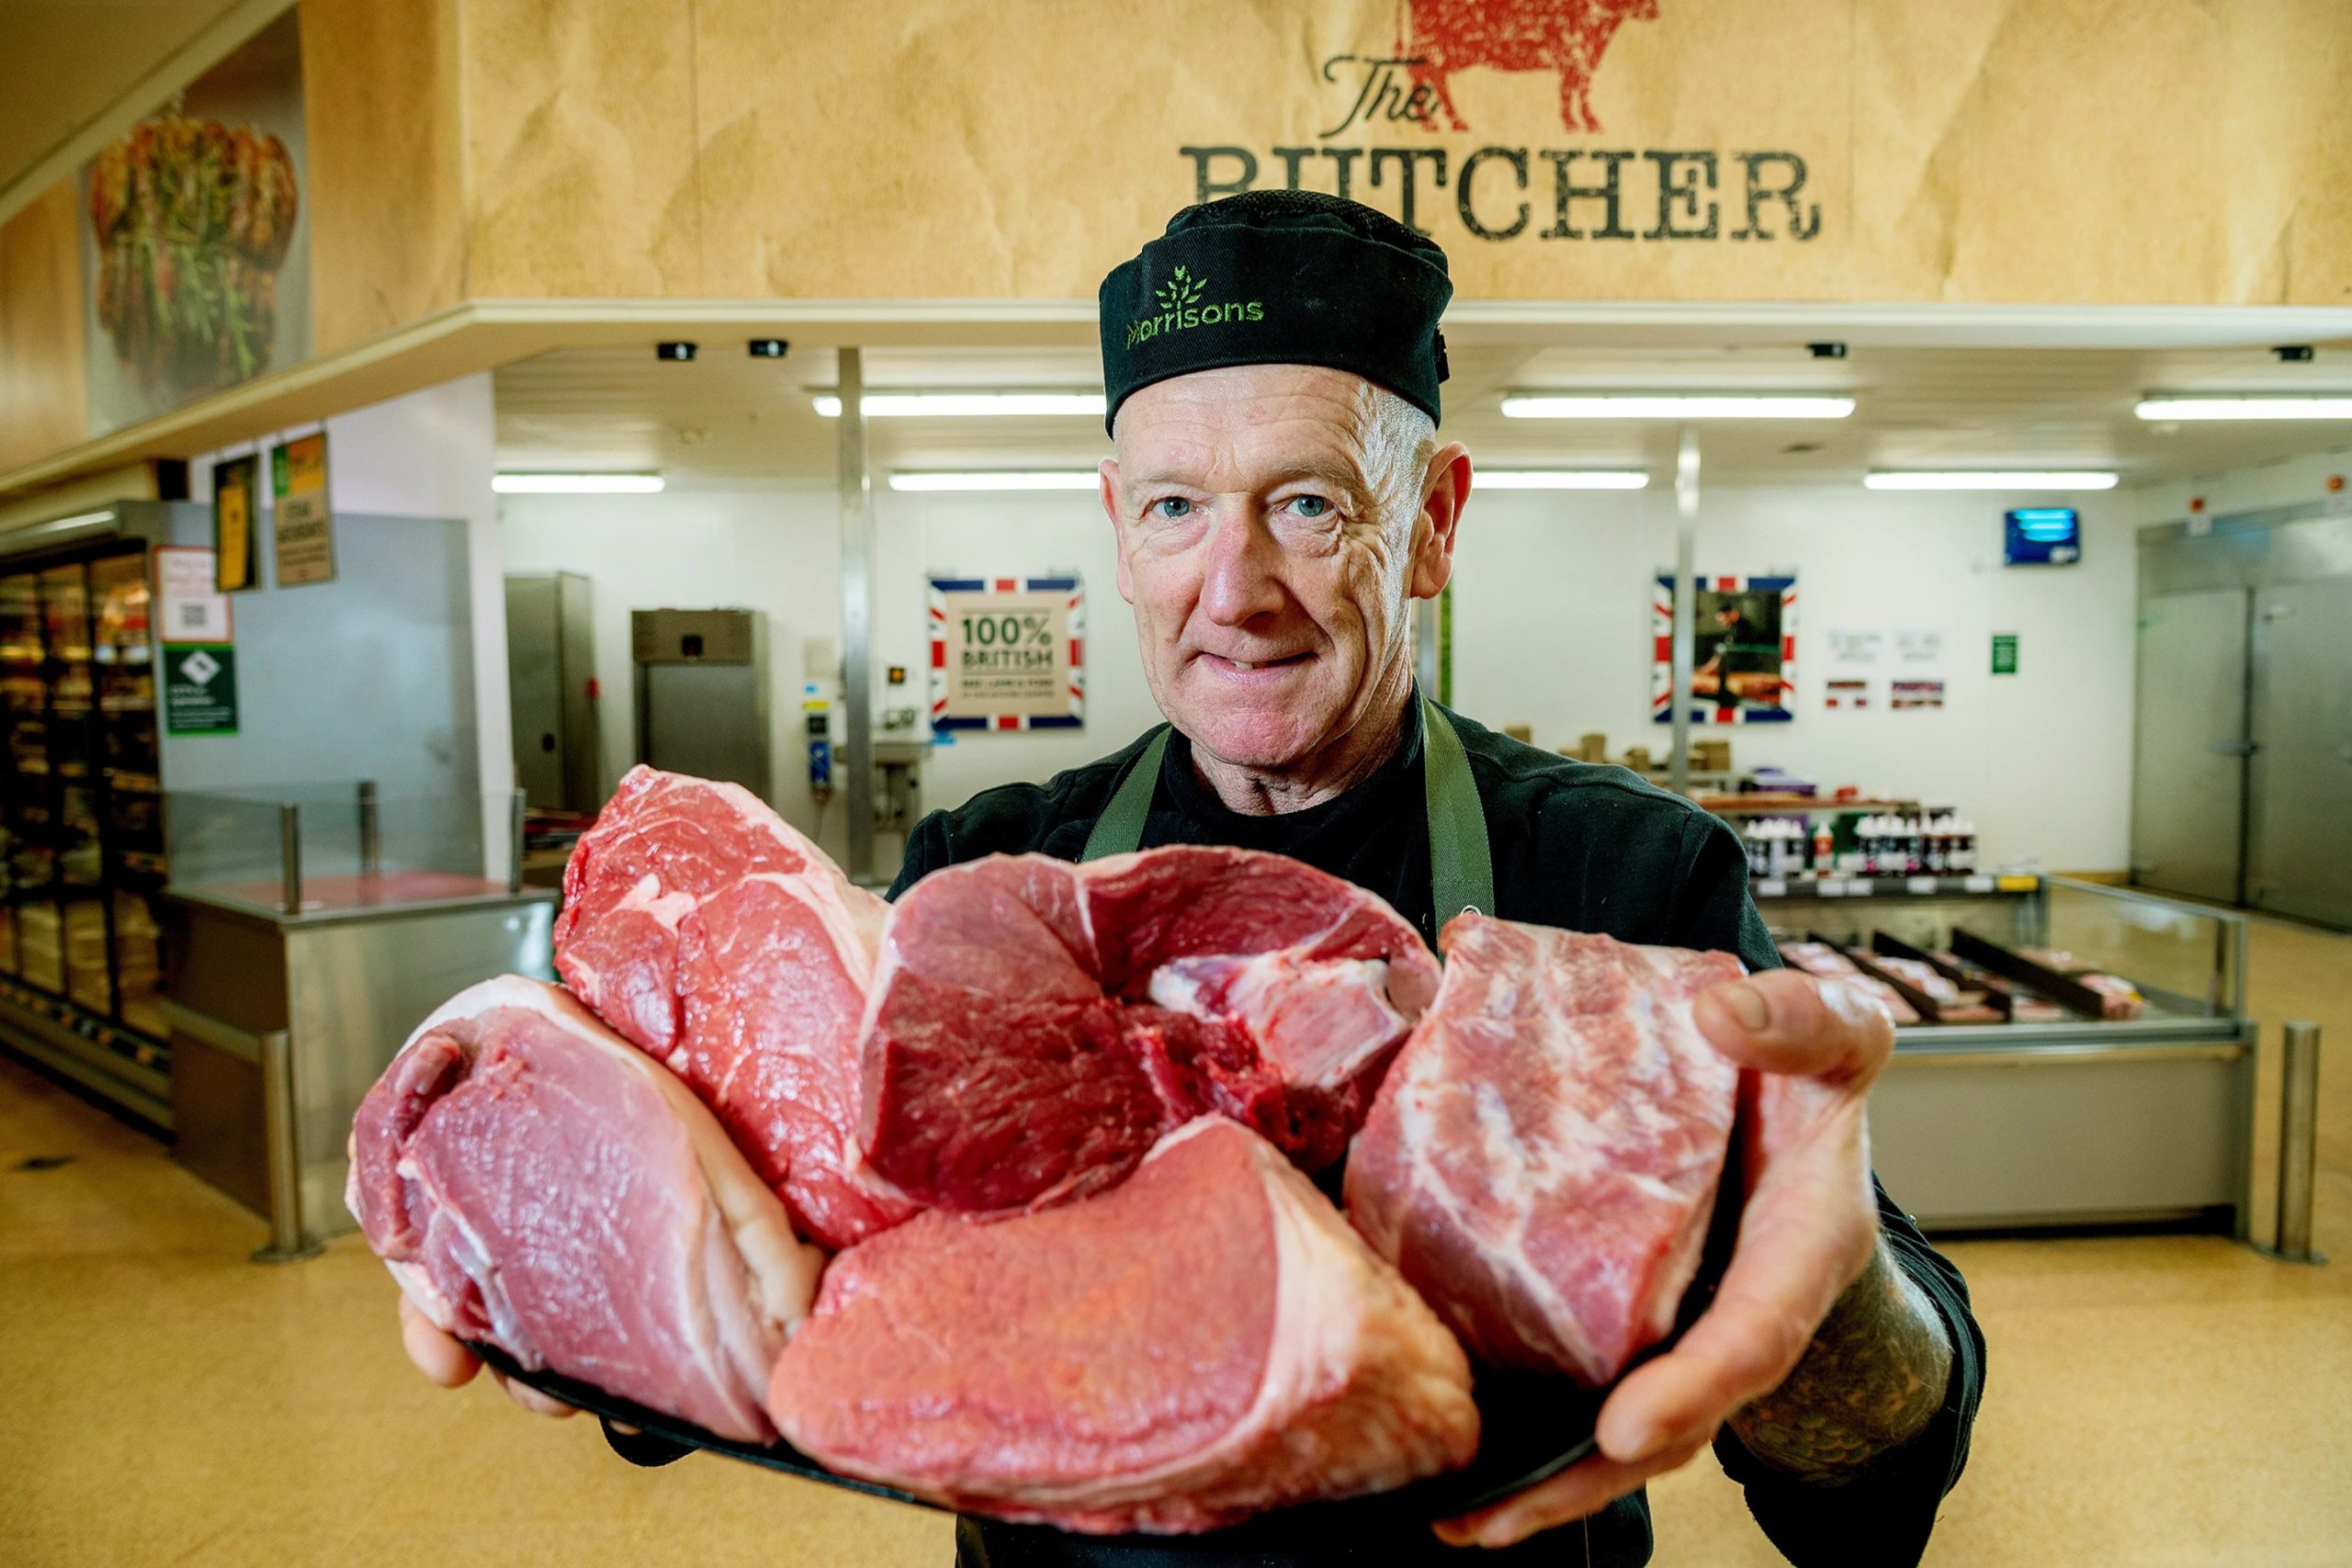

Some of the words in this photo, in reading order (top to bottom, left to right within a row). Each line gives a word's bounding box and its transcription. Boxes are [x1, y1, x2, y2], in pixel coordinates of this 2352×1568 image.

[1317, 55, 1441, 139] The
[1125, 300, 1265, 351] Morrisons
[961, 616, 1053, 646] 100%
[962, 649, 1053, 668] BRITISH
